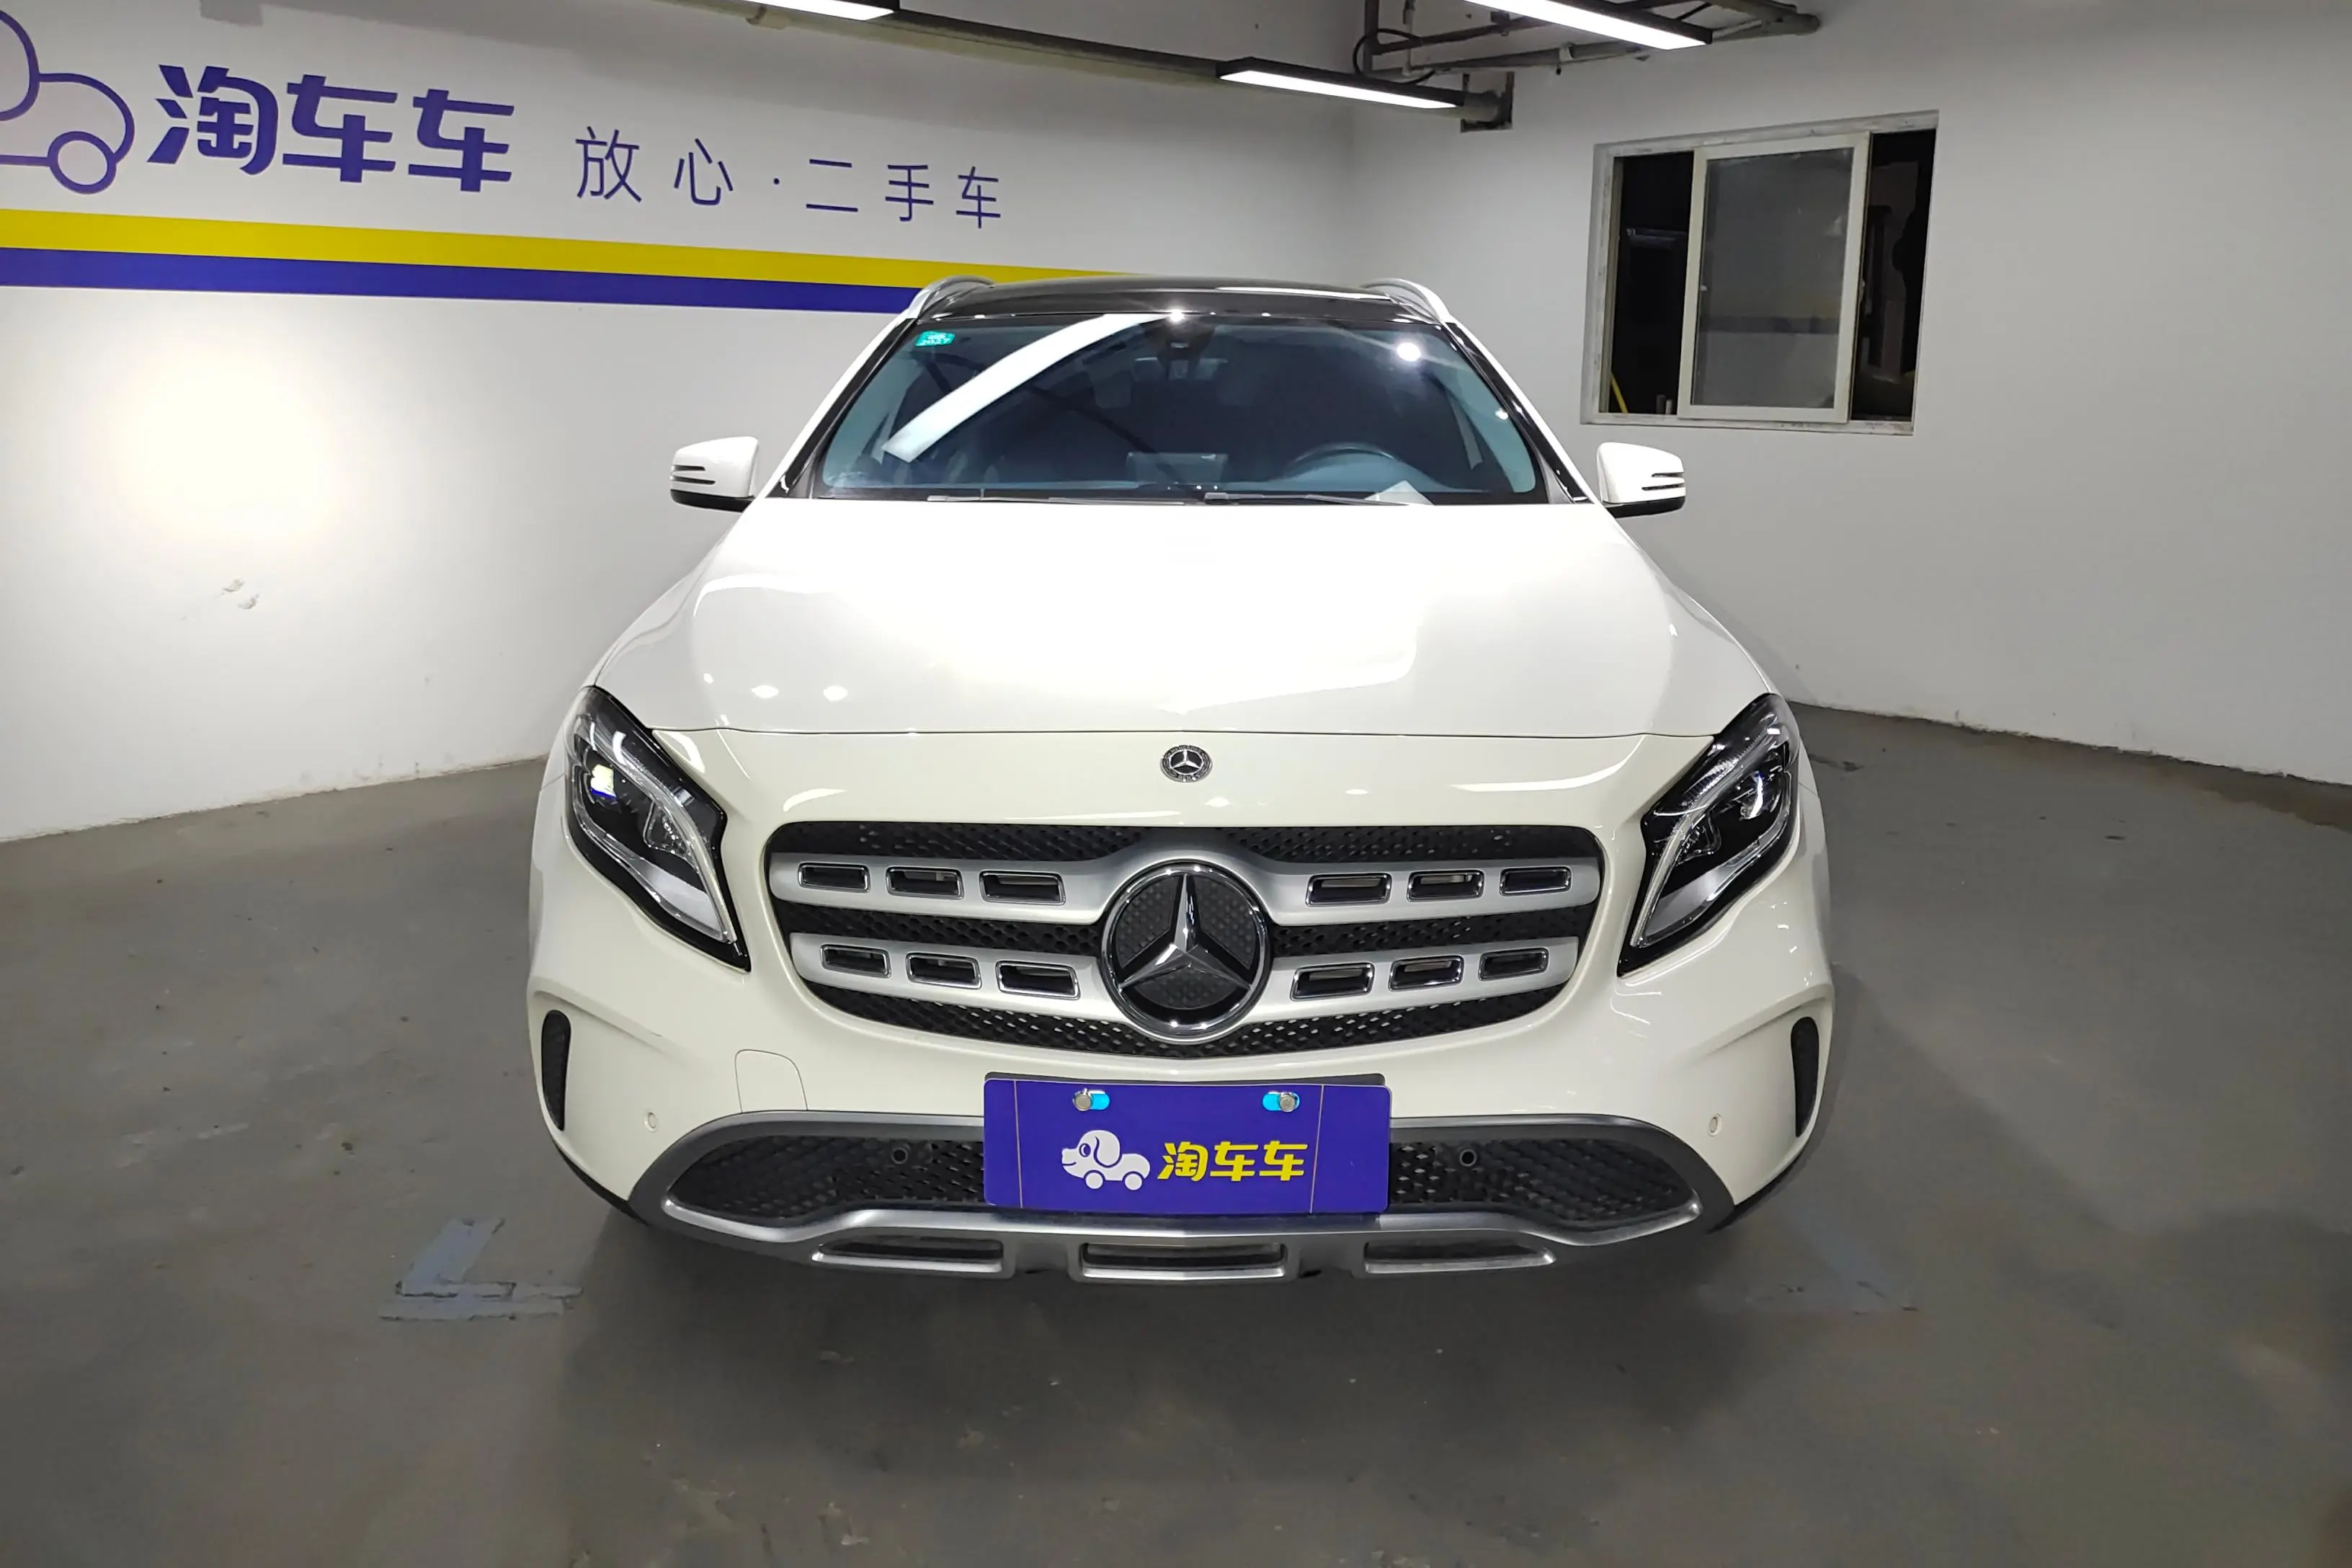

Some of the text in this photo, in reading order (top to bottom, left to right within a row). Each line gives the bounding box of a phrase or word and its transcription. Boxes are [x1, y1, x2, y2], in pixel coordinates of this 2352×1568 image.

[147, 63, 514, 193] 淘车车
[1157, 1140, 1309, 1182] 淘车车
